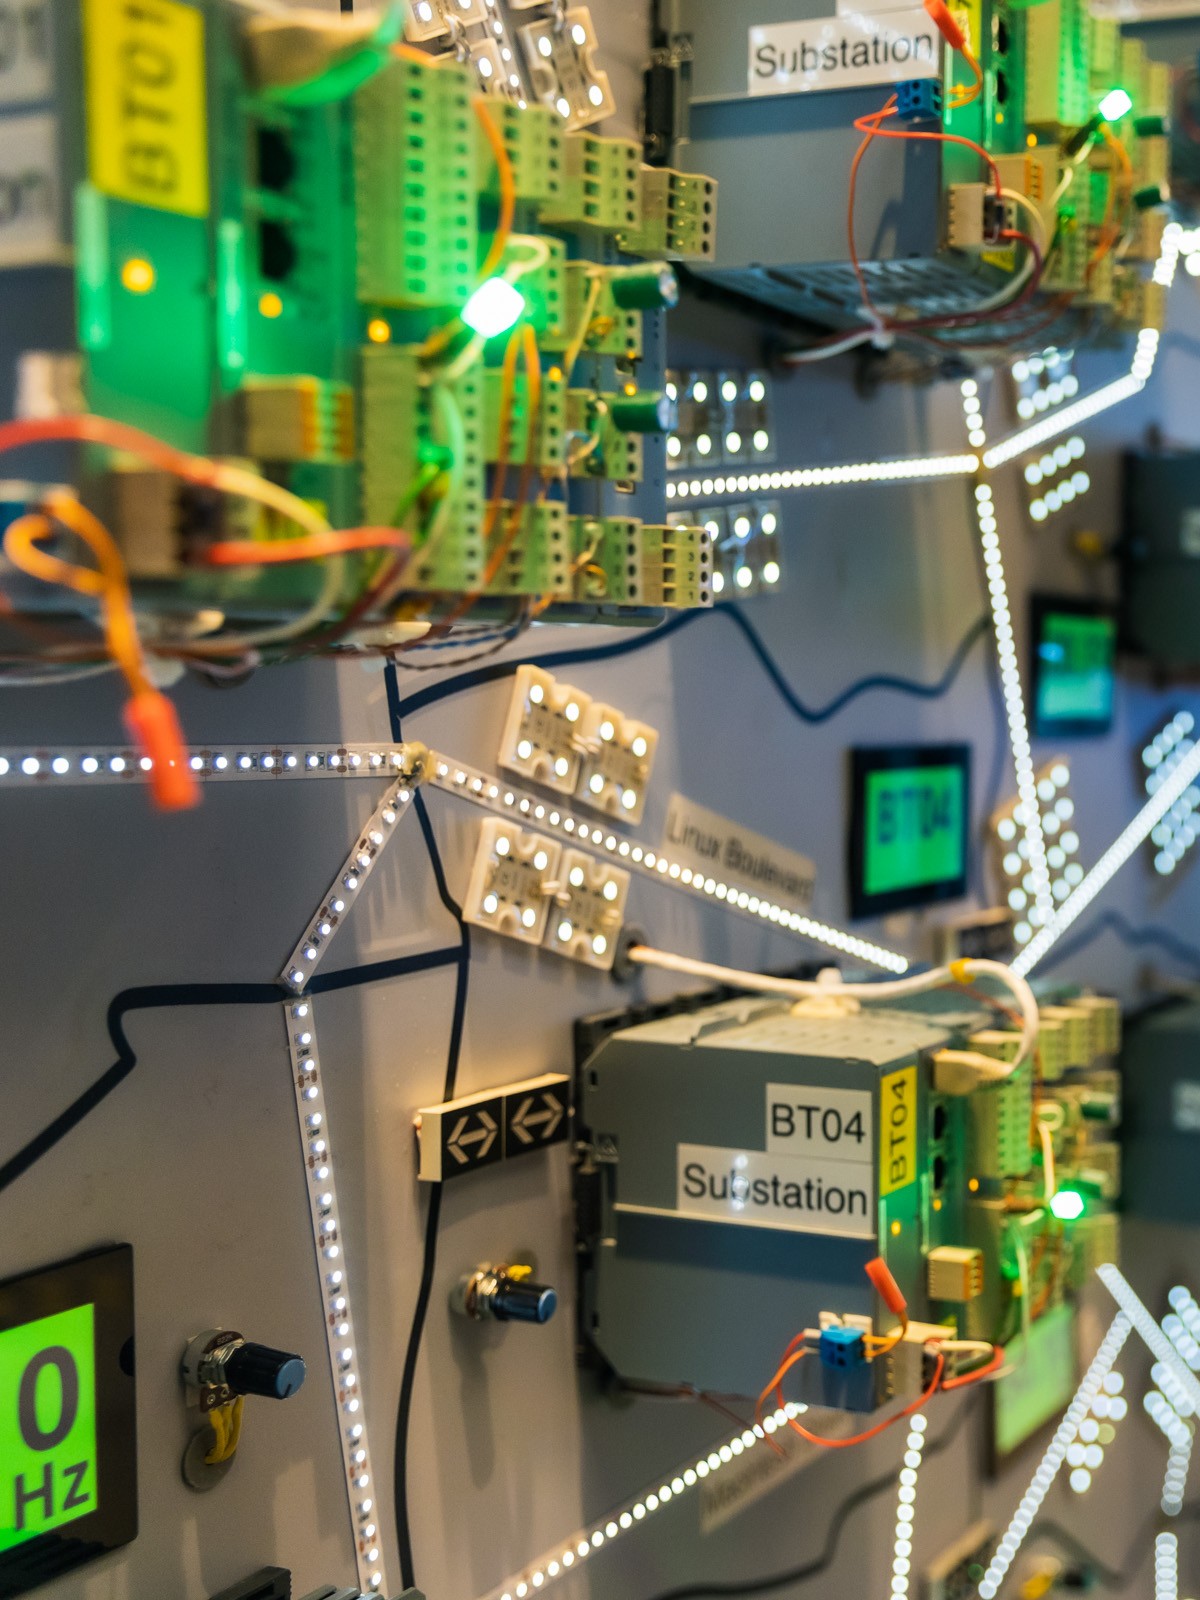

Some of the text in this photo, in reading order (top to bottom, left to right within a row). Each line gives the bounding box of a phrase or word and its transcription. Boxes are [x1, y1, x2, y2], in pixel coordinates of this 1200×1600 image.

[755, 32, 933, 78] Substation
[771, 1103, 866, 1143] BT04
[889, 1077, 908, 1186] BT04
[18, 1345, 79, 1451] 0
[14, 1459, 91, 1533] Hz
